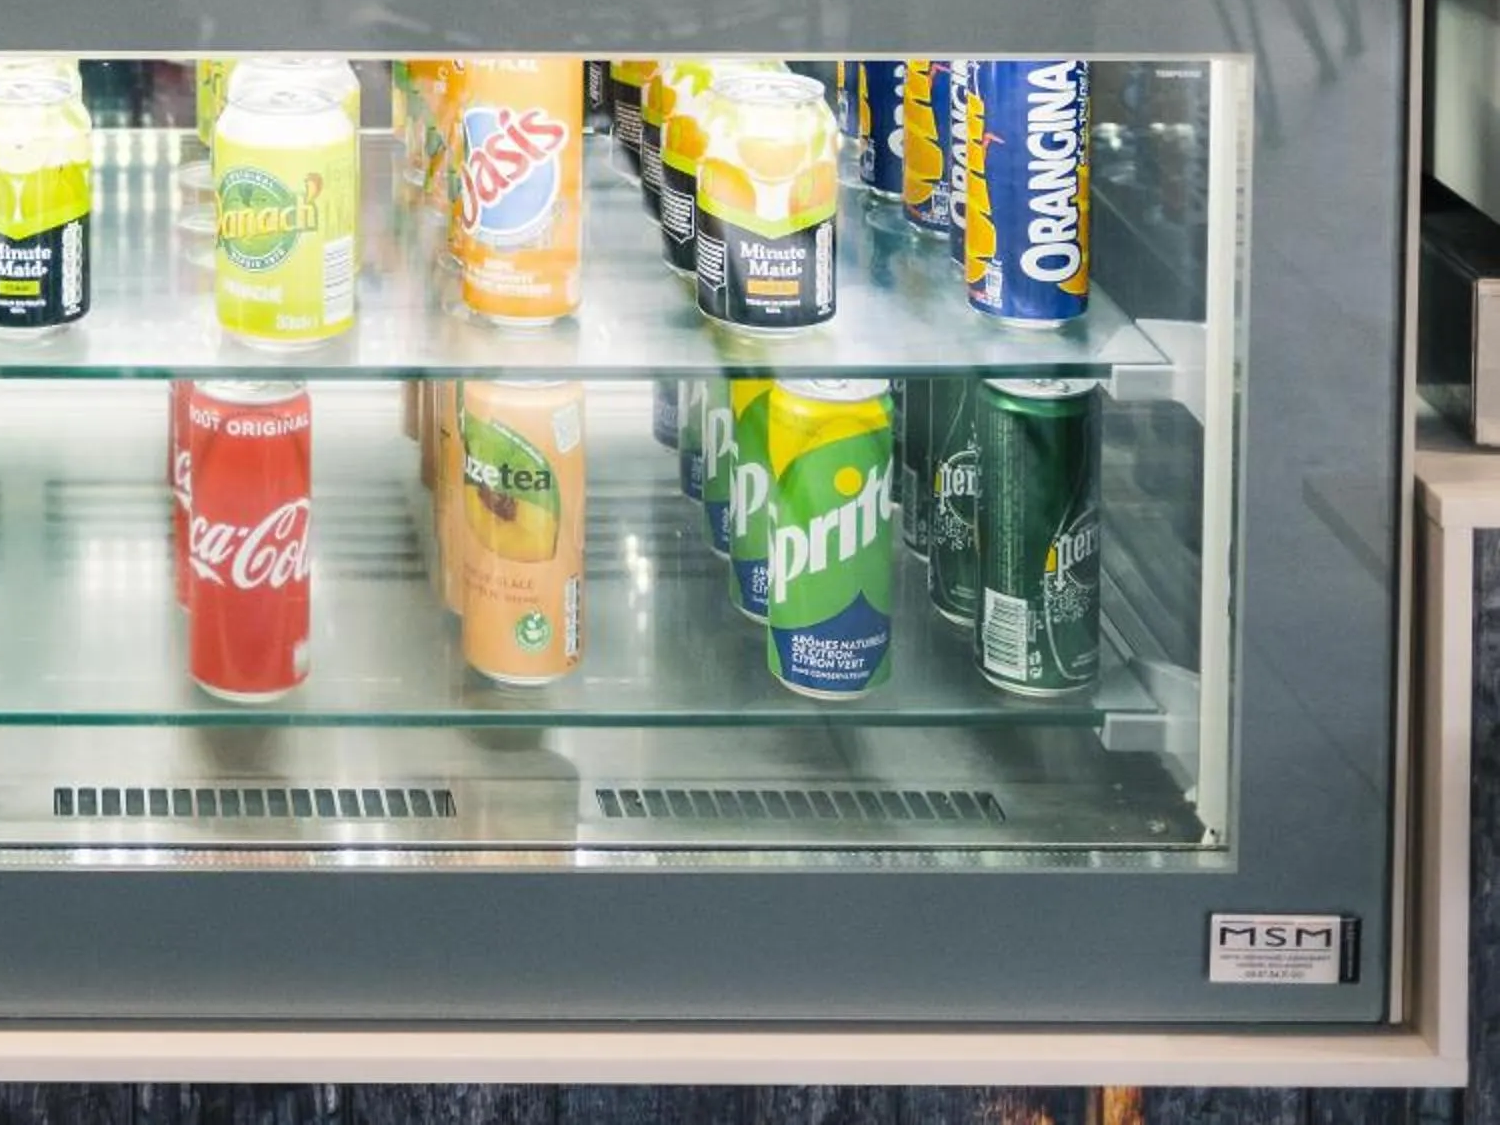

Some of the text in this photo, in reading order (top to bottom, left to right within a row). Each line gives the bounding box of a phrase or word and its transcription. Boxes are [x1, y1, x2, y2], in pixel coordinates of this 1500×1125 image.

[1020, 61, 1081, 282] ORANGINA
[740, 241, 806, 260] Minute
[749, 259, 799, 276] Maid
[1219, 927, 1333, 947] MSM
